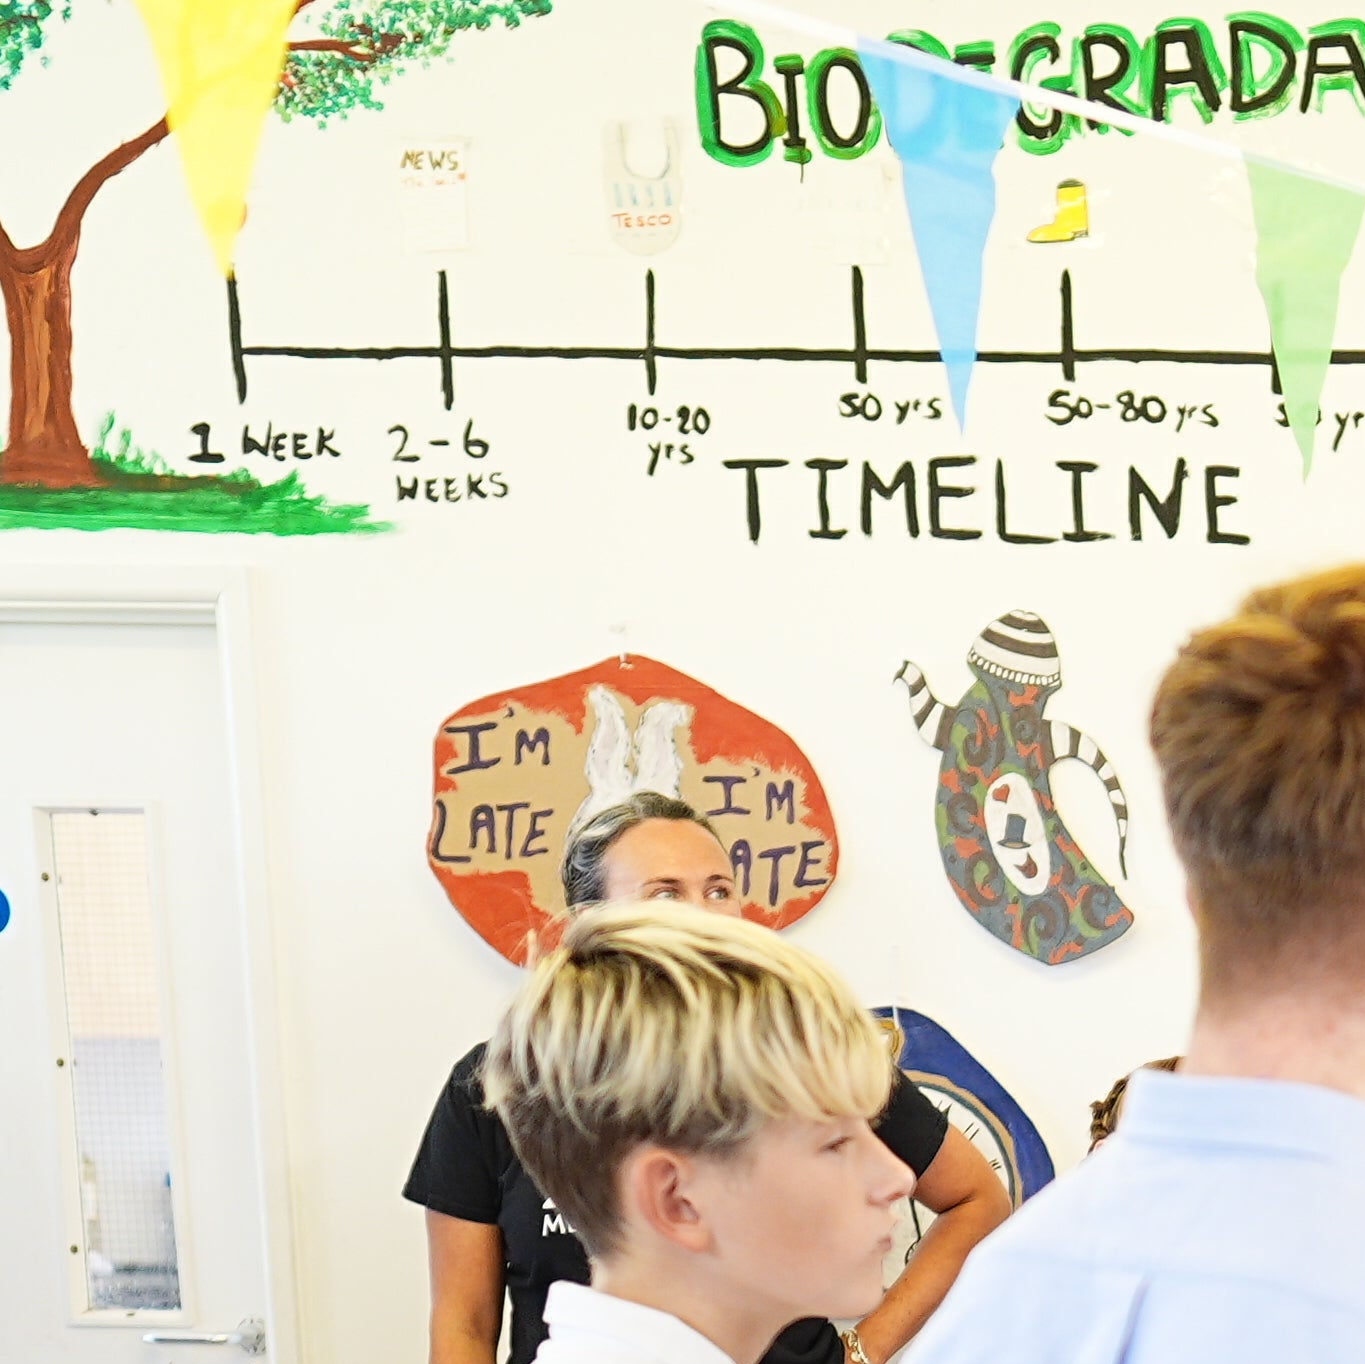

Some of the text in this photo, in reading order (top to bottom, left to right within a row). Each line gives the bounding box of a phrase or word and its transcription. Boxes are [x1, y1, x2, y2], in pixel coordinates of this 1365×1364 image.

[400, 150, 459, 171] NEWS
[627, 403, 711, 435] 10-20
[894, 397, 942, 425] yrs
[1047, 389, 1219, 433] 50-80 yrs
[188, 422, 226, 464] 1
[647, 443, 695, 477] yrs
[396, 472, 508, 503] WEEKS
[722, 455, 1251, 546] TIMELINE
[444, 706, 552, 776] I'M
[703, 767, 796, 825] I'M
[430, 798, 555, 864] LATE
[730, 838, 829, 907] ATE
